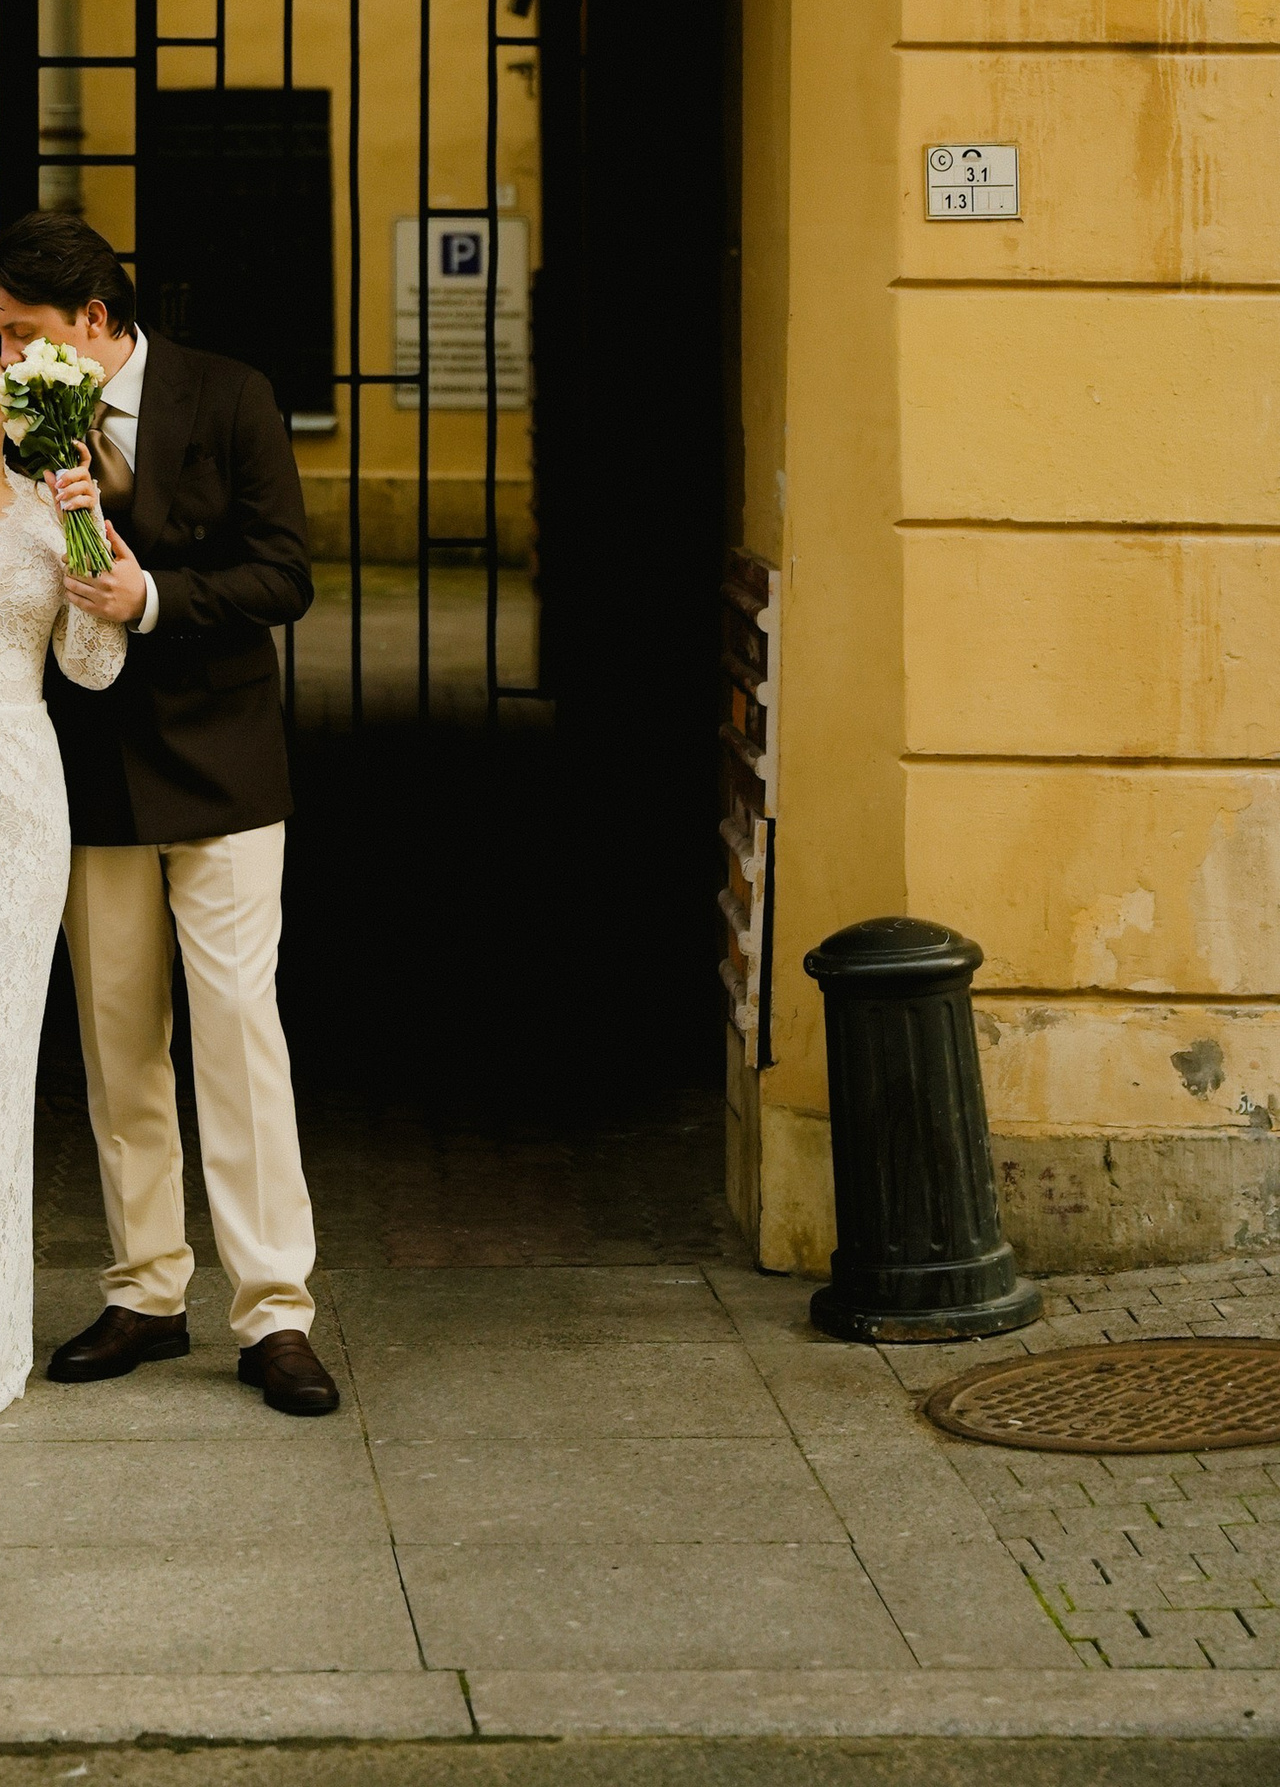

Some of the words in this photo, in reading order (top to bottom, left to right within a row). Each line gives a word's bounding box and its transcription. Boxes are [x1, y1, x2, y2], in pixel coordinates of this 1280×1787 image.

[966, 167, 988, 182] 3.1
[945, 194, 967, 209] 1.3
[451, 237, 476, 273] P
